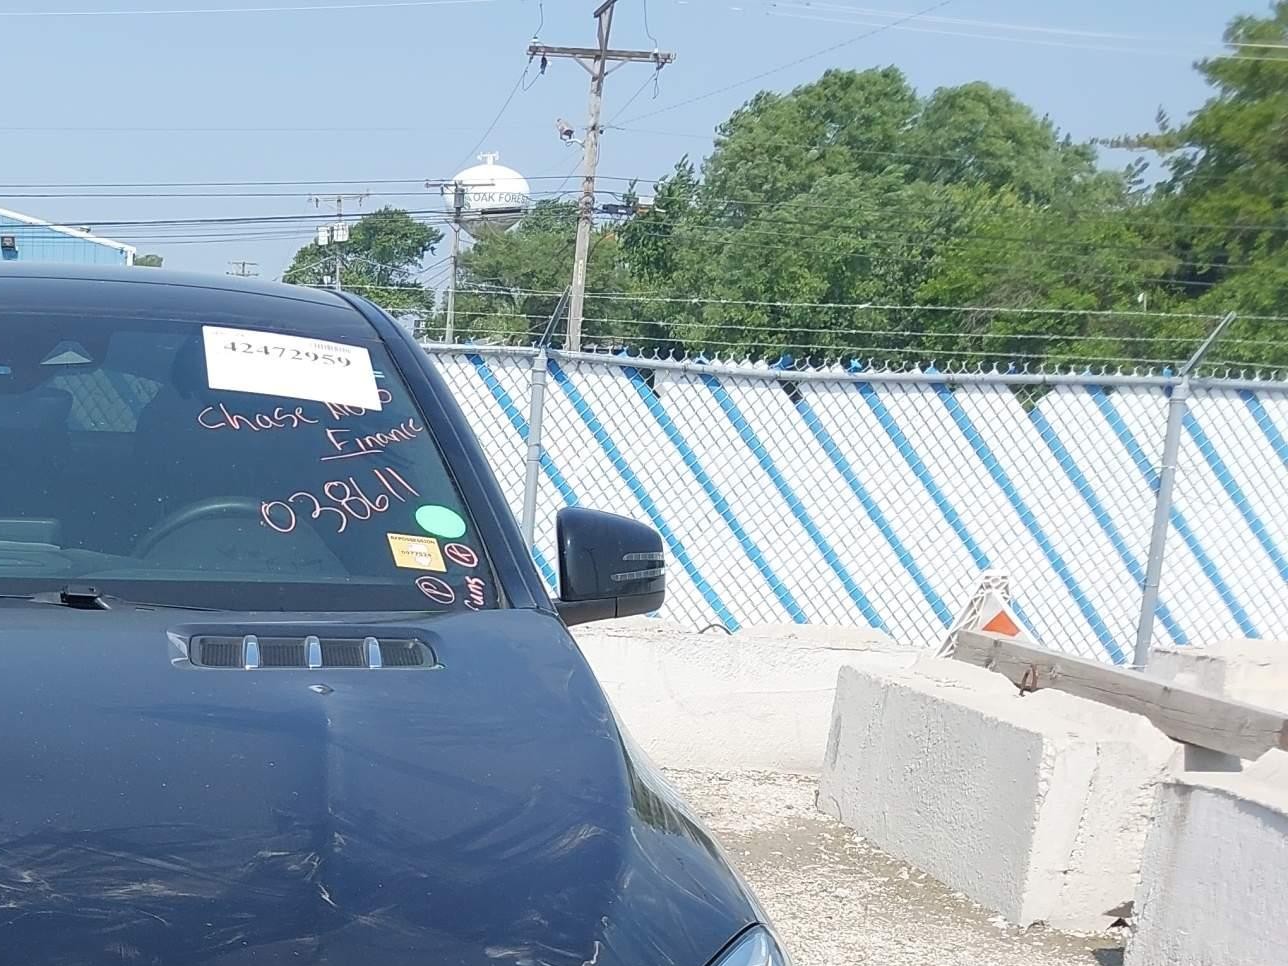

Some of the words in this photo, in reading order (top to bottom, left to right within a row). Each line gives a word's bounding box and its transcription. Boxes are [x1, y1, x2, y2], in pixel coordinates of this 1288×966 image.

[473, 192, 495, 203] OAK
[223, 340, 352, 368] 42472959
[197, 403, 319, 432] Chase
[261, 467, 421, 533] 038611
